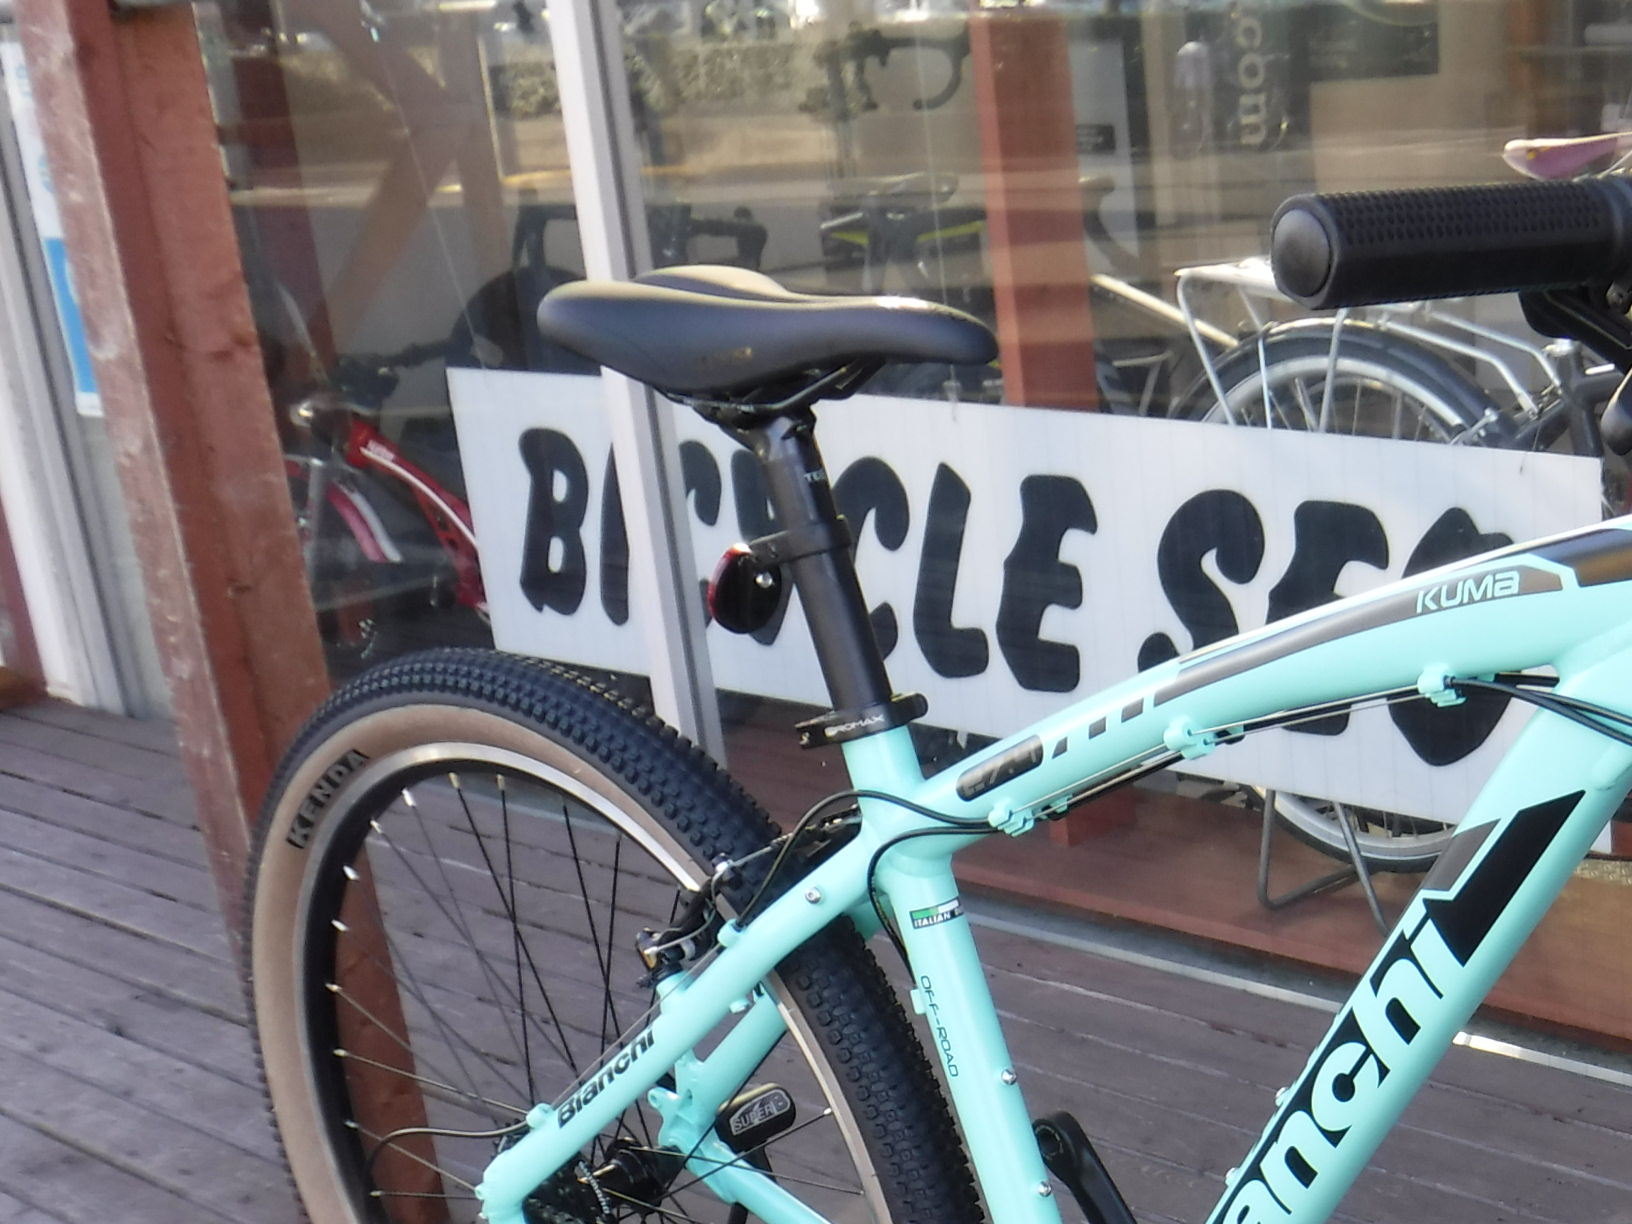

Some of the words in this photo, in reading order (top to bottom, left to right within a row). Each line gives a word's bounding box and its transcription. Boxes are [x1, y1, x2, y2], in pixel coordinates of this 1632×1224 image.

[286, 750, 367, 849] KENDA
[914, 911, 952, 929] ITALIAN
[557, 1022, 655, 1129] Bianchi
[920, 975, 959, 1078] OFF-ROAD
[733, 1101, 777, 1132] SUPER
